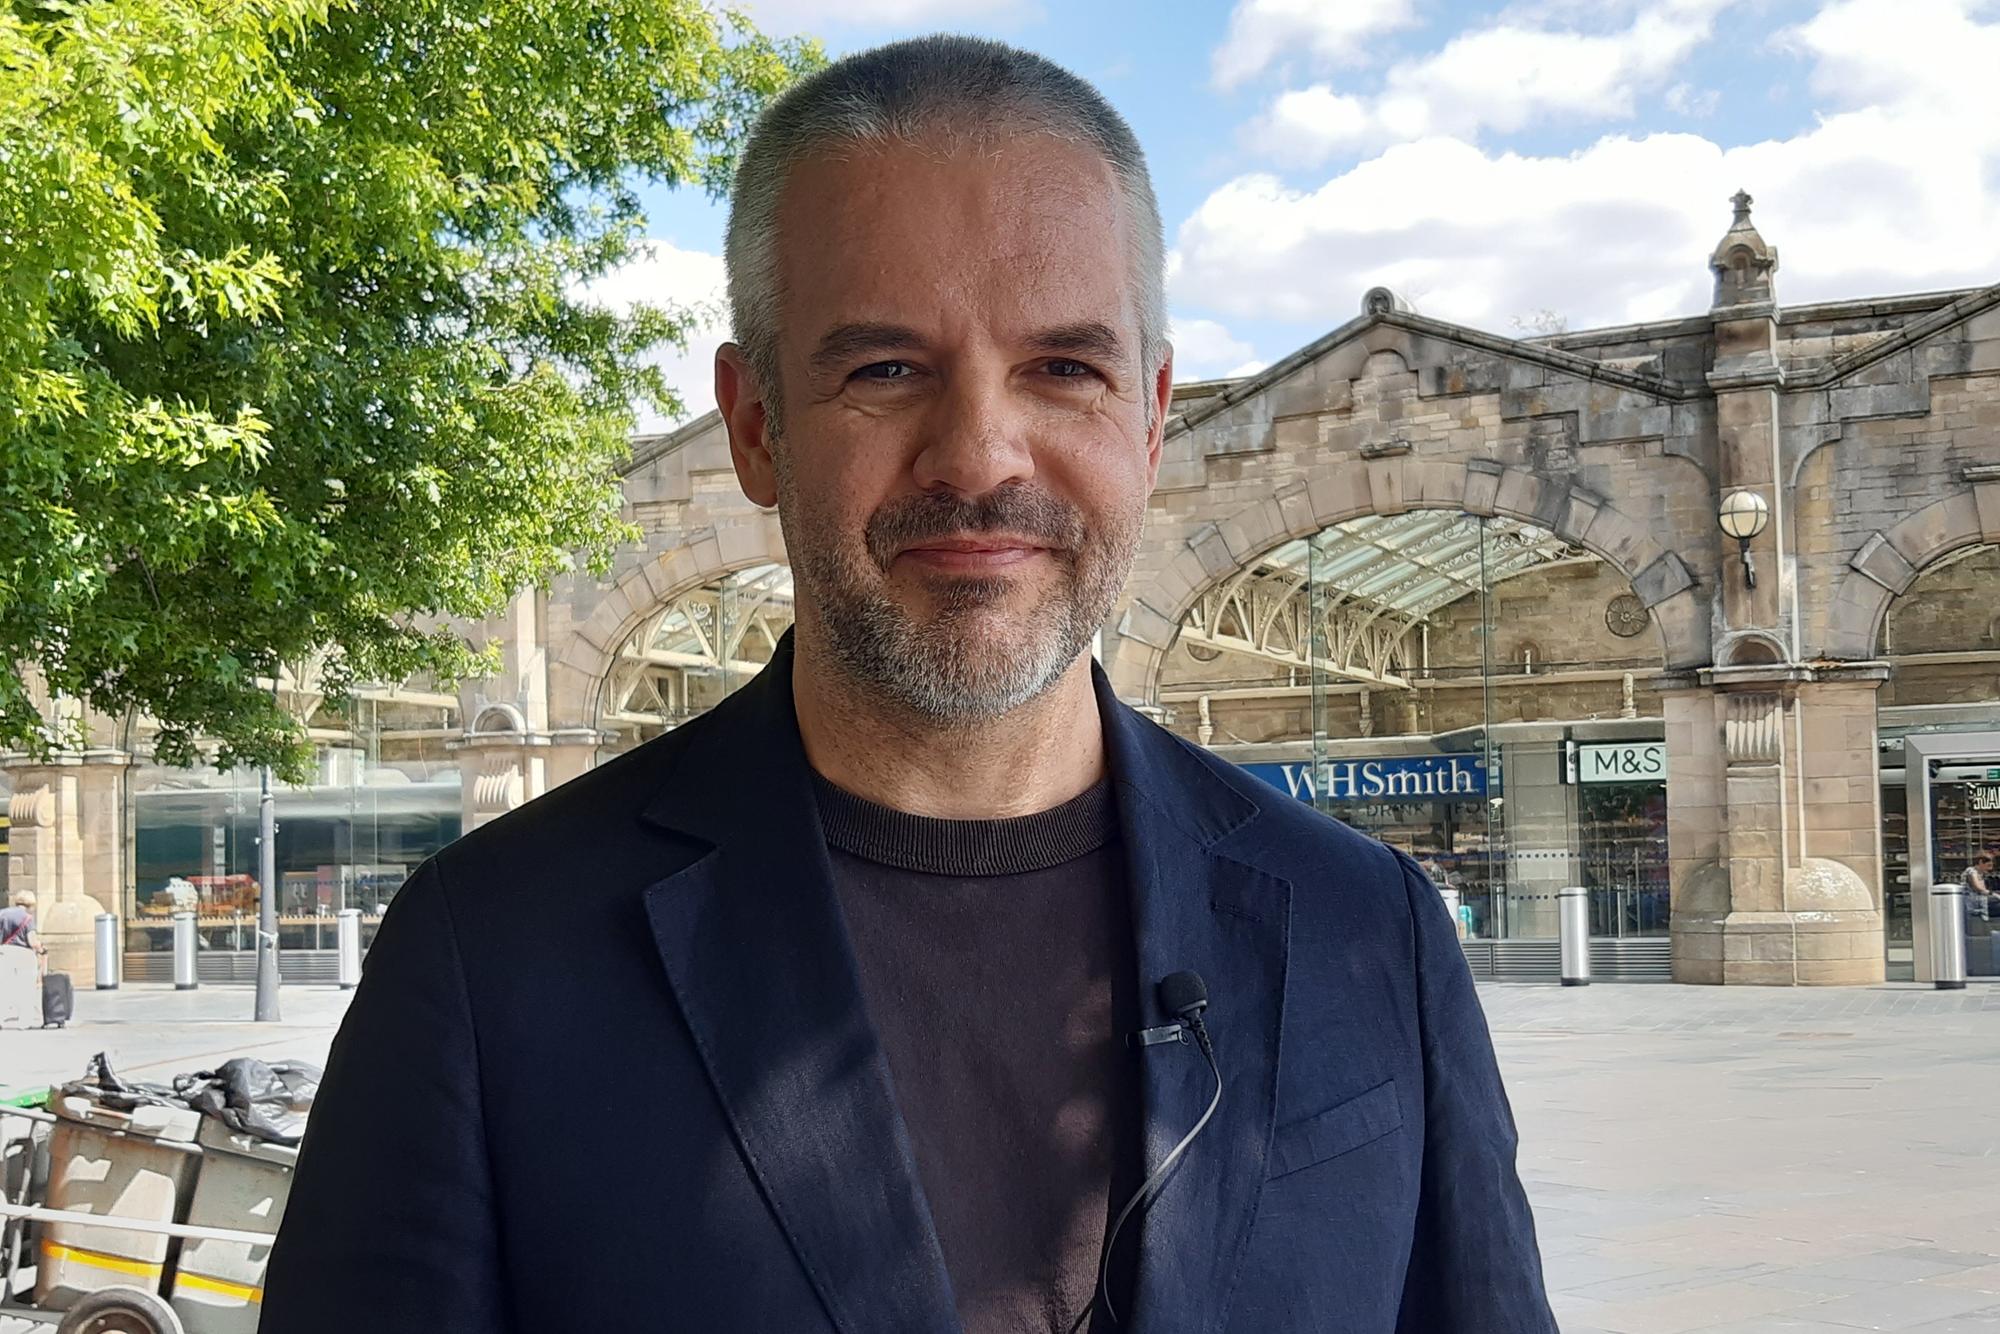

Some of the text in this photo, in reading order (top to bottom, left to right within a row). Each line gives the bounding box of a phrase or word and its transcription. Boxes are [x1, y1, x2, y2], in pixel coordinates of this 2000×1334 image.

[1595, 747, 1661, 774] M&S
[1281, 759, 1475, 798] WHSmith
[1366, 803, 1425, 817] DRNK
